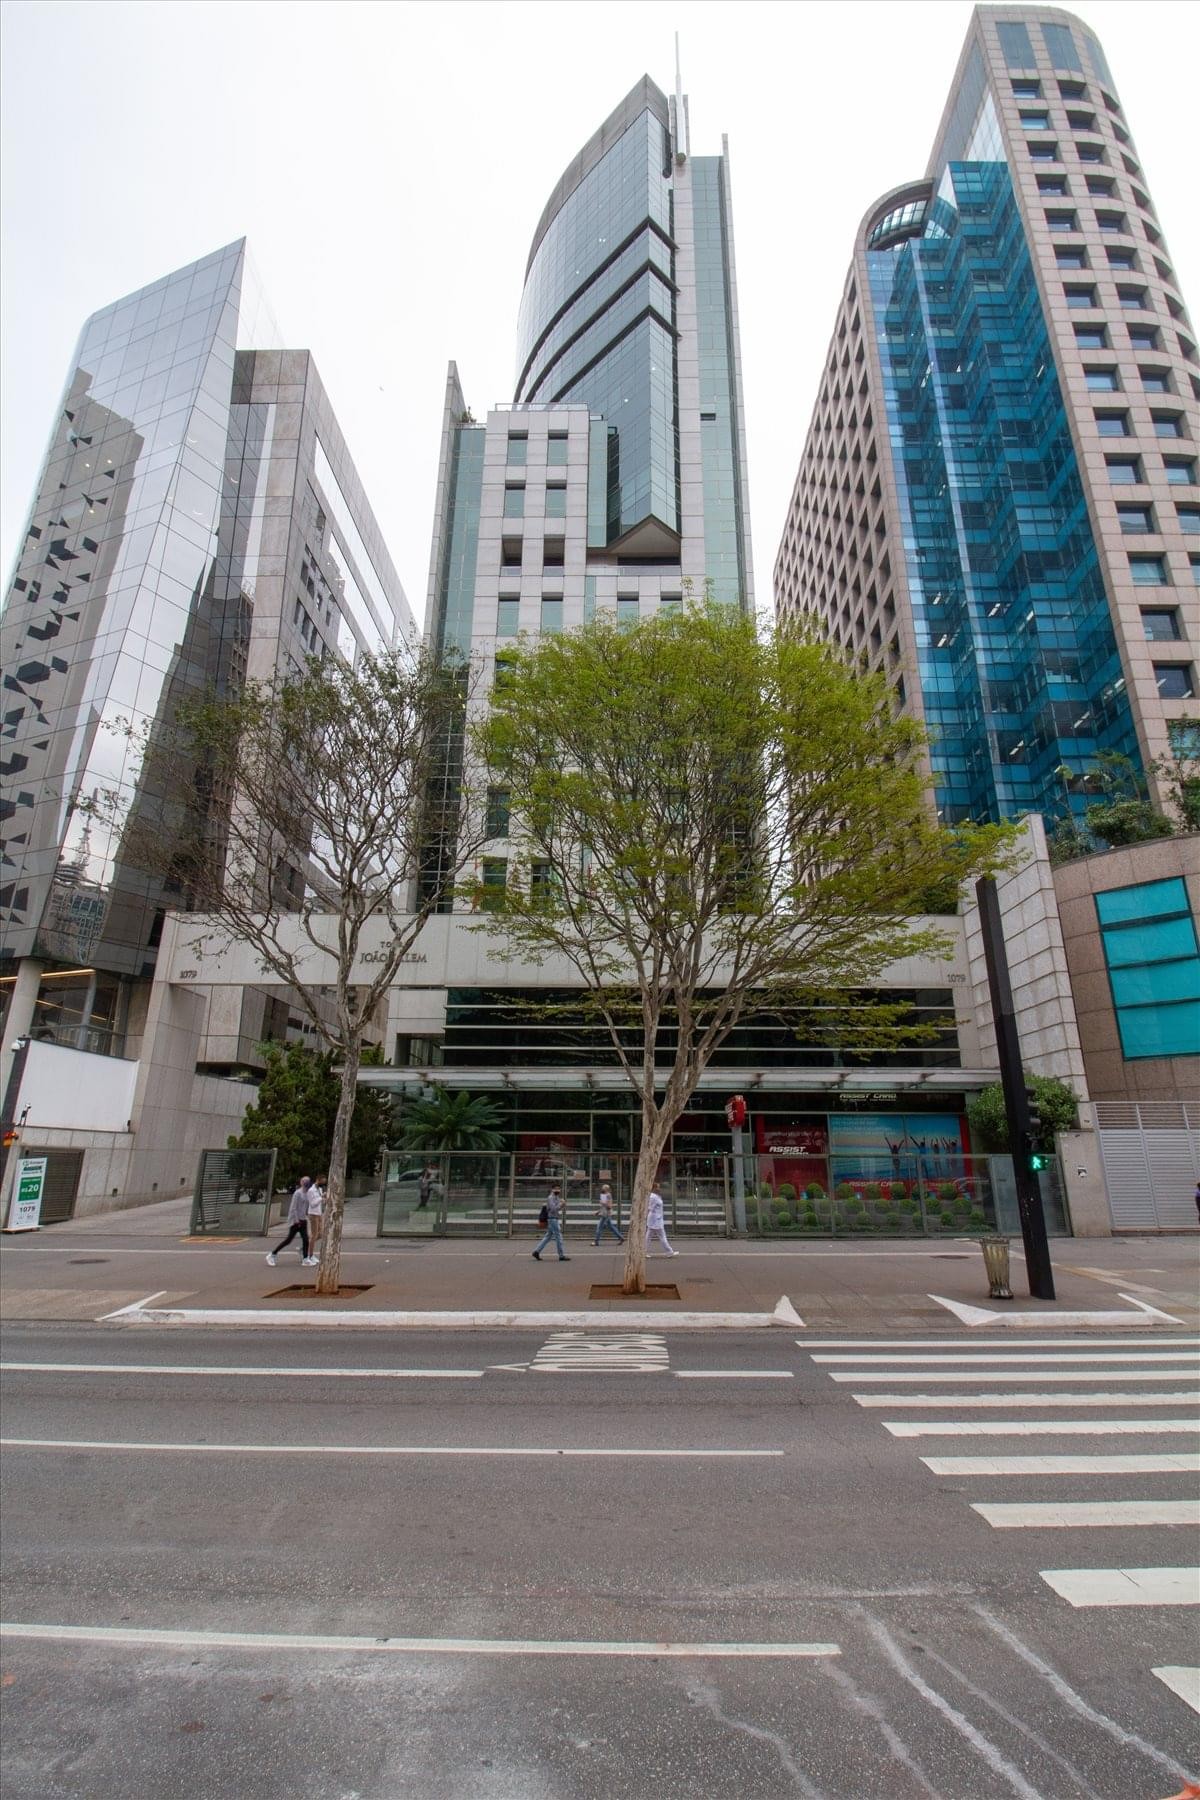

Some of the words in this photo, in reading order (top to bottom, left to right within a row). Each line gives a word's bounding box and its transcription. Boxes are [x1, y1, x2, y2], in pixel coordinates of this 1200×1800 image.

[360, 951, 388, 964] JOÃO
[180, 970, 198, 979] 1079
[947, 973, 966, 983] 1079
